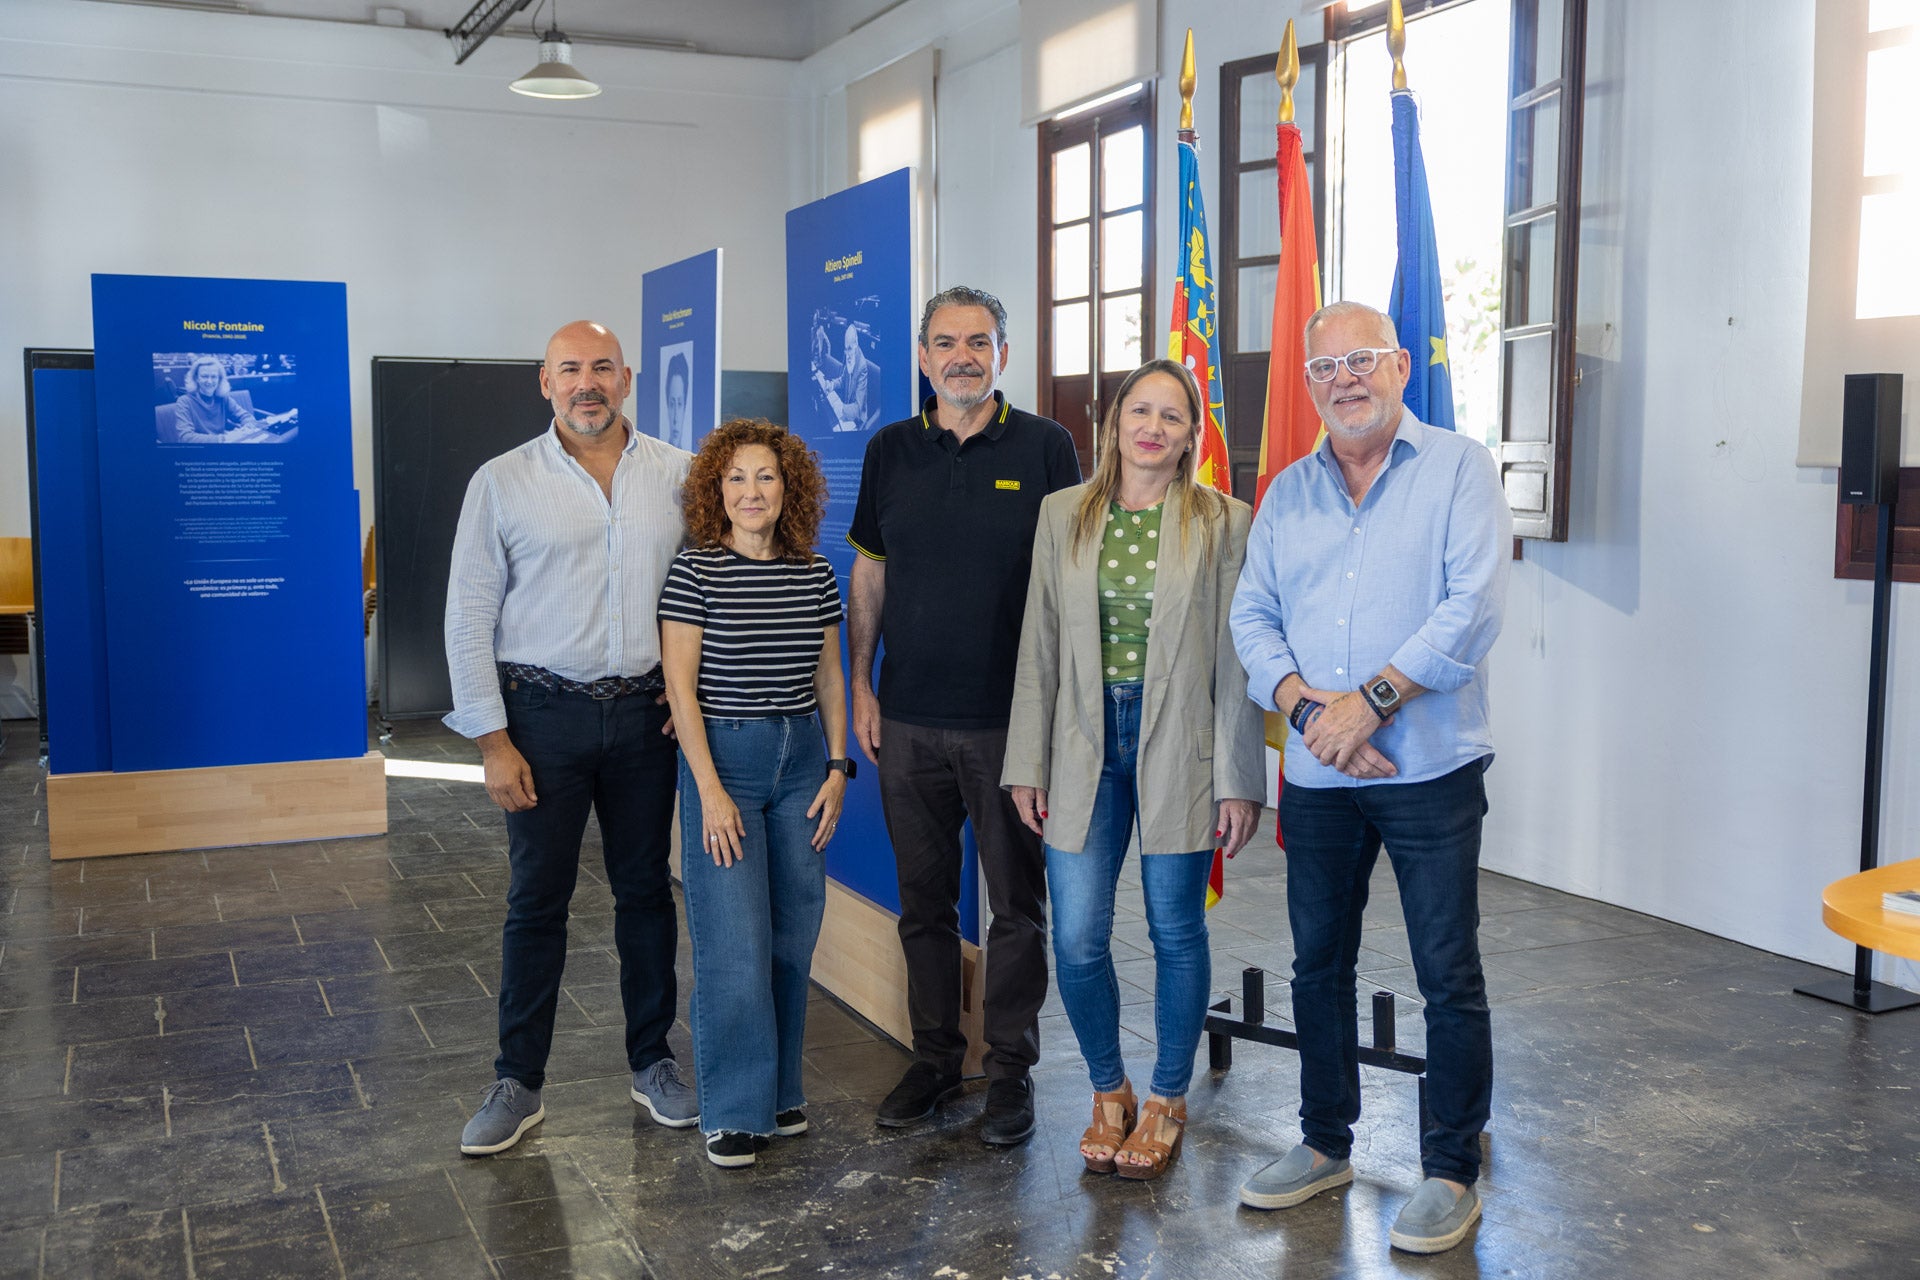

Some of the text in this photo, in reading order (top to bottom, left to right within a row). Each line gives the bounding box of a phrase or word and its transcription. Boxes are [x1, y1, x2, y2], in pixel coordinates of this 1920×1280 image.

[825, 250, 862, 272] Altiero Spinelli
[183, 320, 264, 332] Nicole Fontaine
